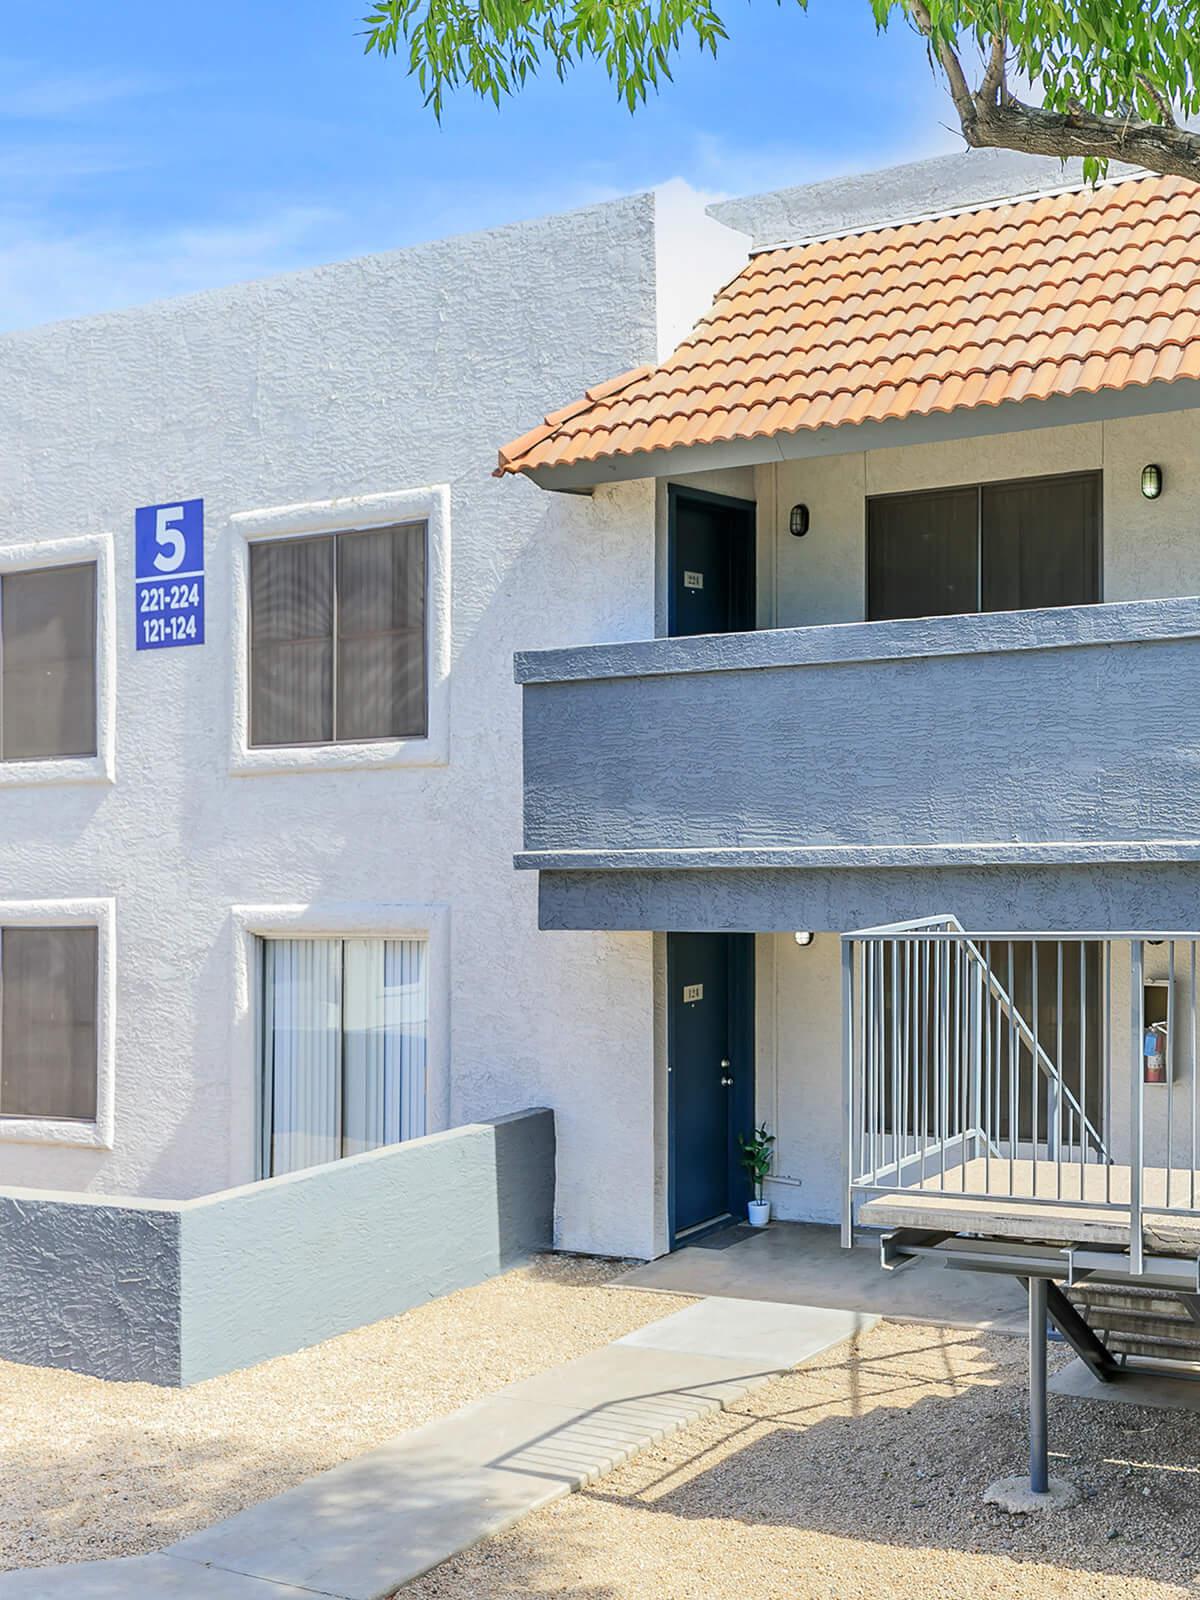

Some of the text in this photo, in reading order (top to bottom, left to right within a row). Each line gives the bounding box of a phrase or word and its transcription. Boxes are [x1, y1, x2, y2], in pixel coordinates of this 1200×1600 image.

[153, 506, 186, 572] 5
[140, 583, 200, 613] 221-224
[143, 615, 197, 643] 121-124
